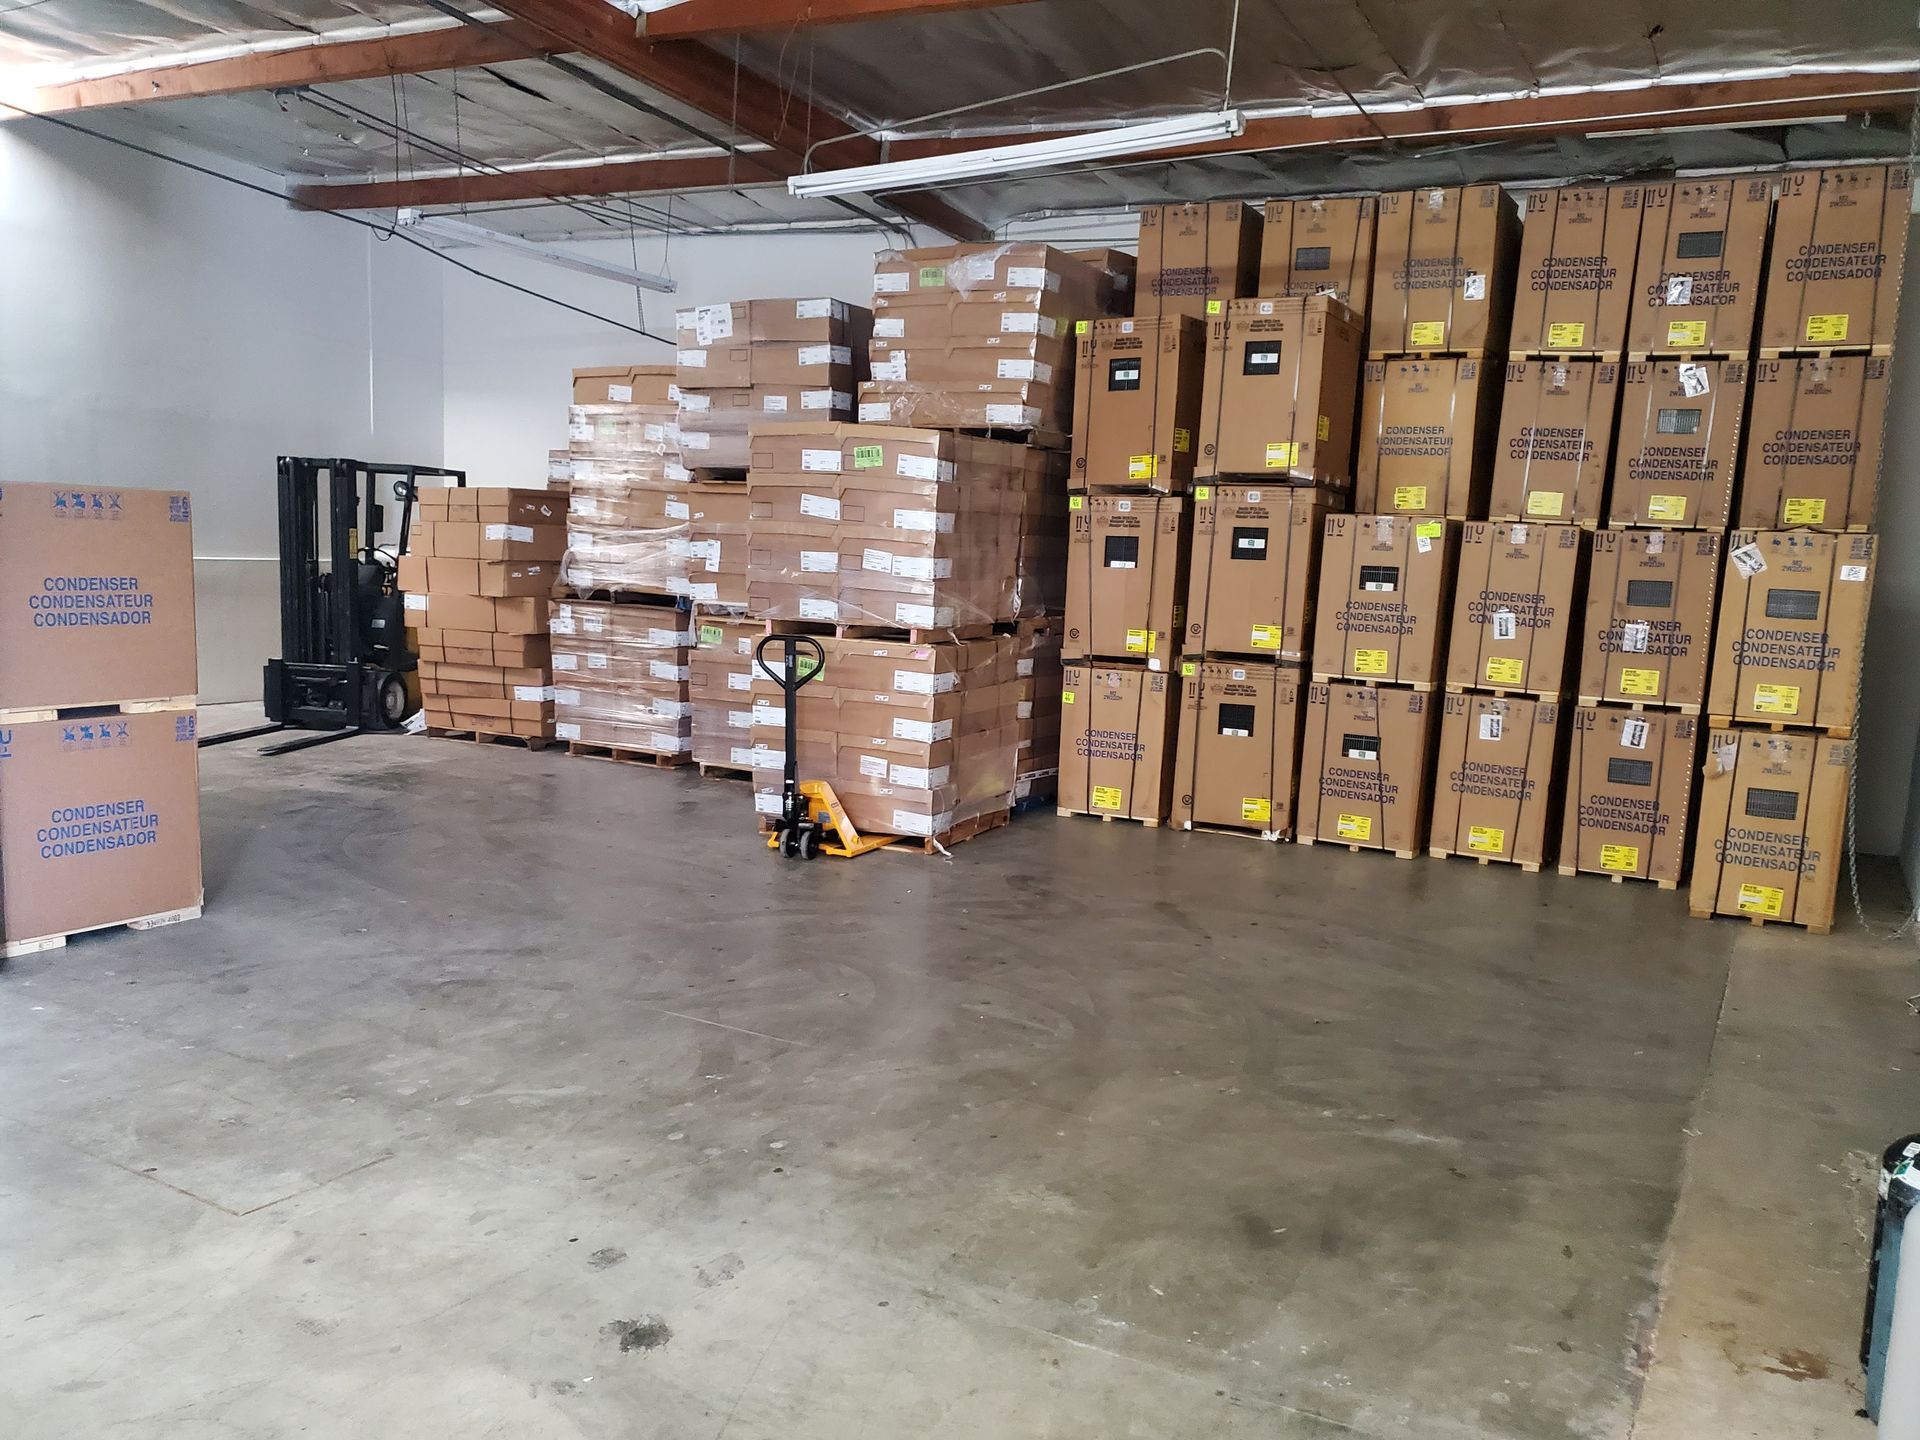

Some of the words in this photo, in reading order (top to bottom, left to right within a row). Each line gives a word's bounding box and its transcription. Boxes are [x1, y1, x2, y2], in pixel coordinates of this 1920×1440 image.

[1798, 242, 1876, 256] CONDENSER
[1542, 257, 1608, 267] CONDENSER
[1785, 254, 1887, 269] CONDENSATEUR
[1160, 267, 1212, 276] CONDENSER
[1530, 268, 1617, 279] CONDENSATEUR
[1531, 281, 1613, 291] CONDENSADOR
[1386, 426, 1444, 434] CONDENSER
[1775, 430, 1851, 440] CONDENSER
[1762, 441, 1861, 453] CONDENSATEUR
[1763, 454, 1856, 465] CONDENSADOR
[44, 577, 138, 591] CONDENSER
[29, 594, 153, 609] CONDENSATEUR
[1480, 590, 1546, 604] CONDENSER
[1346, 601, 1408, 612] CONDENSER
[34, 611, 151, 627] CONDENSADOR
[1335, 612, 1417, 624] CONDENSATEUR
[1336, 622, 1414, 635] CONDENSADOR
[1746, 629, 1829, 643] CONDENSER
[1732, 641, 1841, 658] CONDENSATEUR
[1733, 654, 1836, 672] CONDENSADOR
[1076, 738, 1146, 752] CONDENSATEUR
[1077, 748, 1143, 761] CONDENSADOR
[1328, 767, 1390, 781] CONDENSER
[1450, 771, 1536, 789] CONDENSATEUR
[1319, 776, 1399, 794] CONDENSATEUR
[1451, 783, 1532, 800] CONDENSADOR
[1320, 786, 1396, 804] CONDENSADOR
[1590, 794, 1659, 811] CONDENSER
[52, 799, 145, 823] CONDENSER
[1579, 805, 1670, 824] CONDENSATEUR
[37, 814, 159, 842] CONDENSATEUR
[1579, 817, 1666, 836] CONDENSADOR
[40, 830, 156, 859] CONDENSADOR
[1727, 828, 1810, 847] CONDENSER
[1714, 839, 1821, 861] CONDENSATEUR
